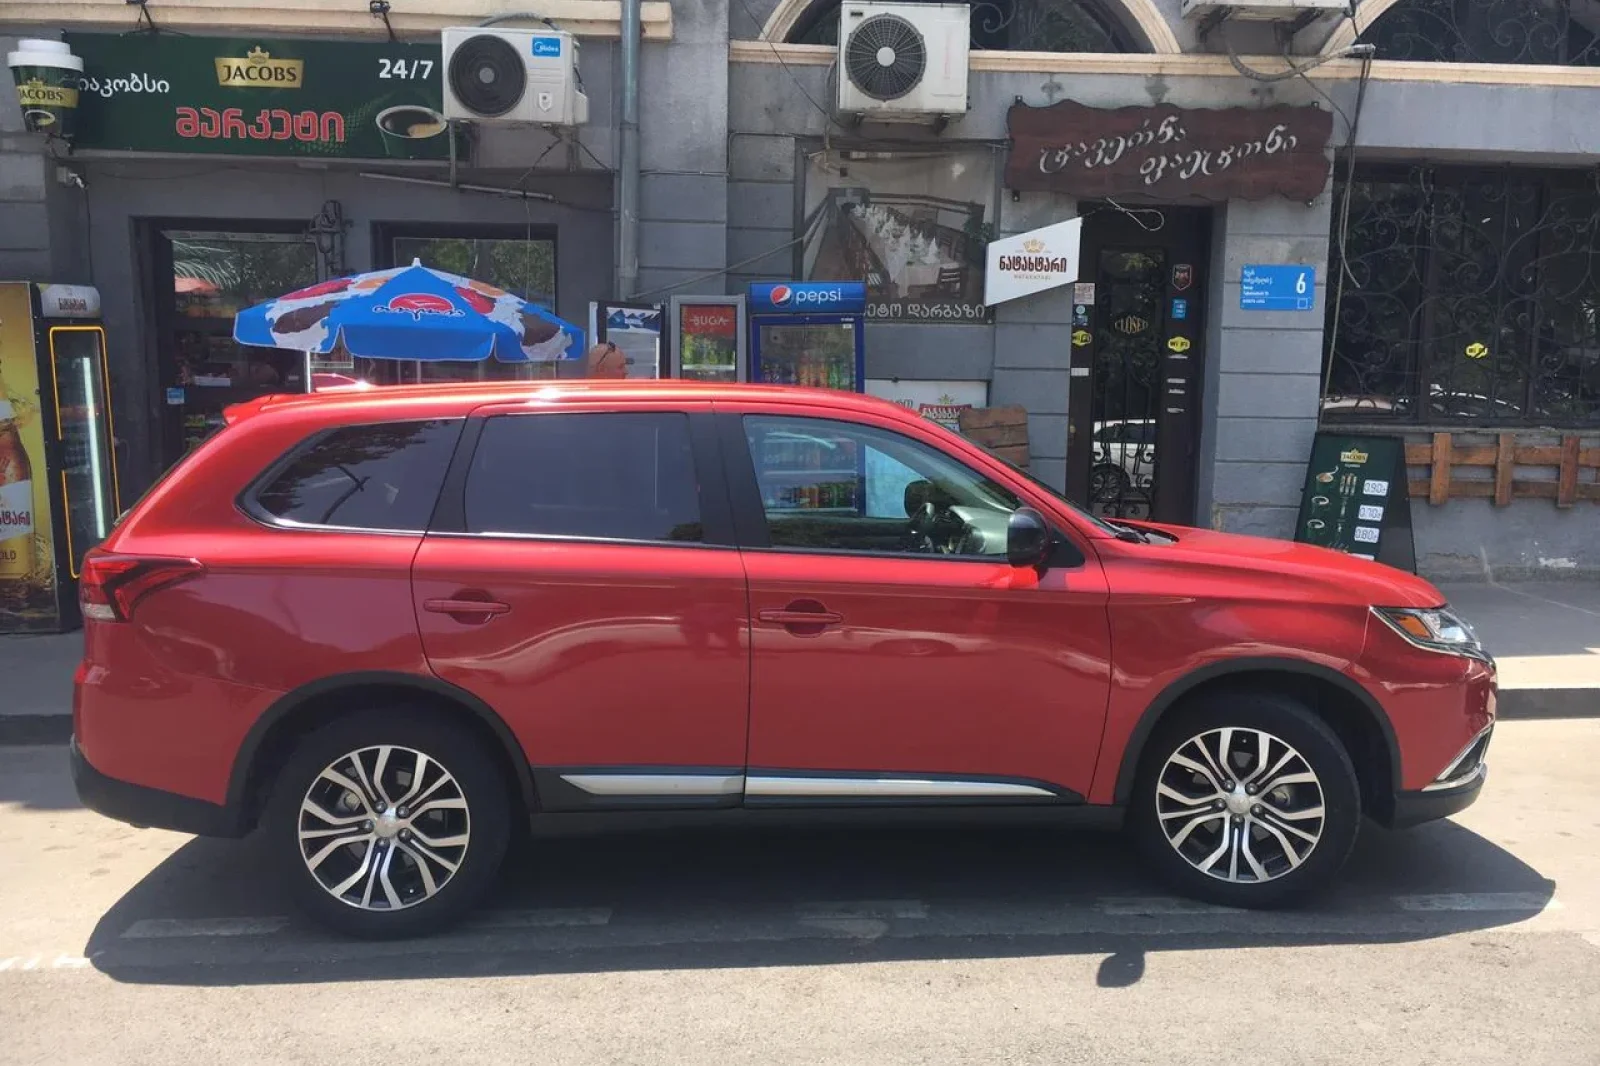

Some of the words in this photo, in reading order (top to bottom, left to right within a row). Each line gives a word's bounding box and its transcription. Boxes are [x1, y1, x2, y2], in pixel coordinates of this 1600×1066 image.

[222, 64, 298, 82] JACOBS
[379, 58, 434, 80] 24/7
[176, 107, 345, 142] მარკეტი
[998, 255, 1067, 273] ნატახტარი
[1296, 272, 1306, 294] 6
[796, 288, 841, 305] pepsi
[864, 303, 902, 318] ეტო
[907, 302, 985, 319] დარბაზი
[1114, 315, 1148, 335] CLOSED
